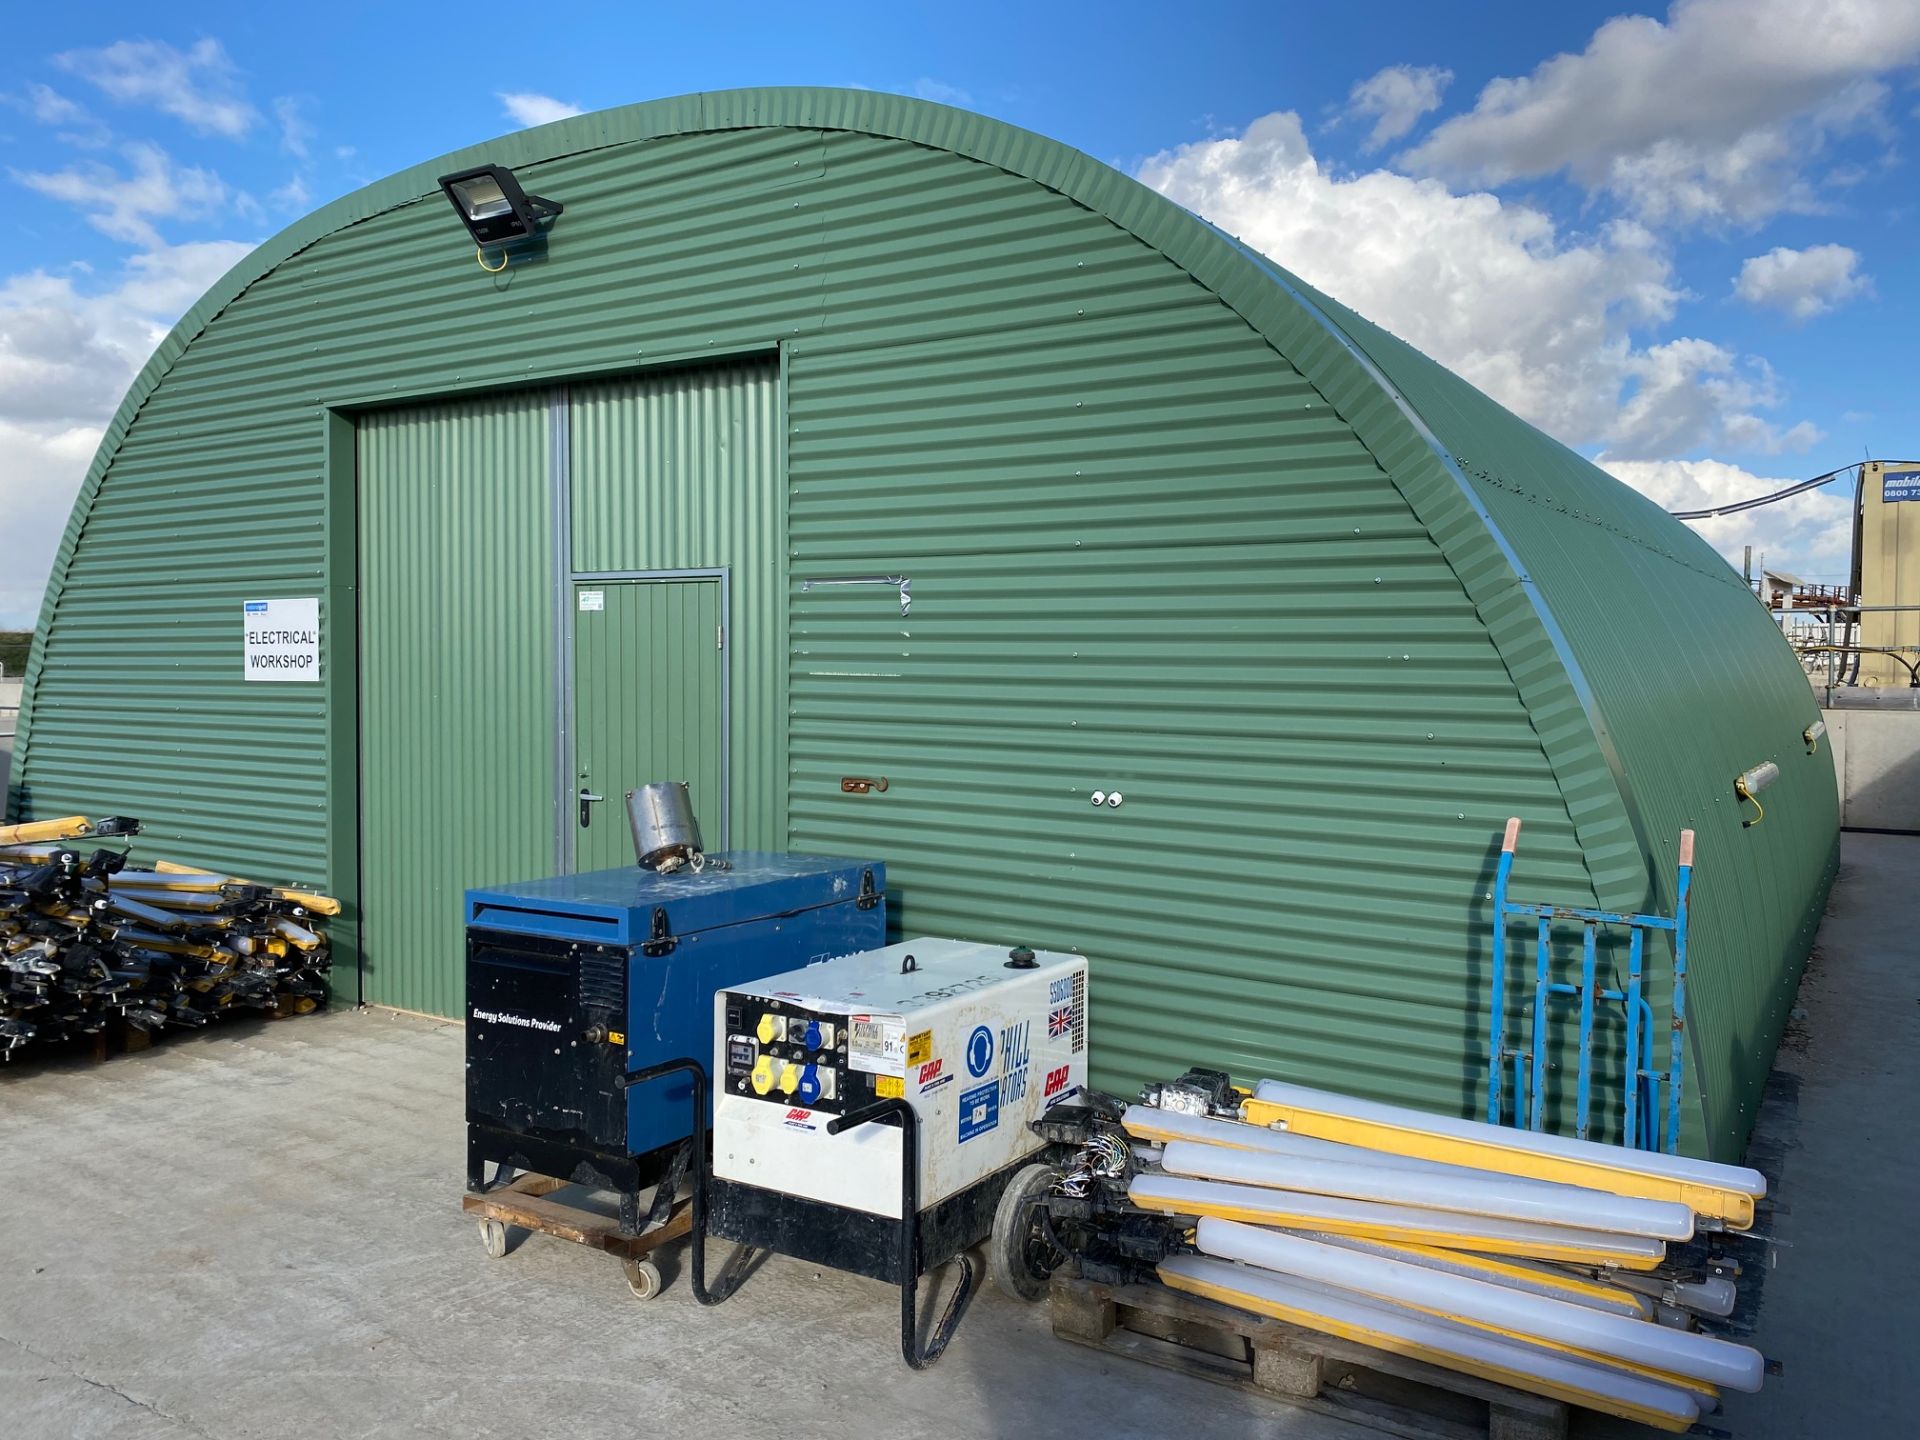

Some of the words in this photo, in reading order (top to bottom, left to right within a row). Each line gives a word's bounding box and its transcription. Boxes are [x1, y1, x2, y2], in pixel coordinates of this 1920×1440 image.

[249, 631, 315, 645] ELECTRICAL
[250, 654, 313, 669] WORKSHOP
[473, 1008, 498, 1024] Energy
[498, 1013, 530, 1027] Solutions
[530, 1018, 562, 1032] Provider
[885, 1040, 893, 1052] 91
[1000, 1066, 1028, 1108] ATORS
[1044, 1065, 1070, 1097] GAP
